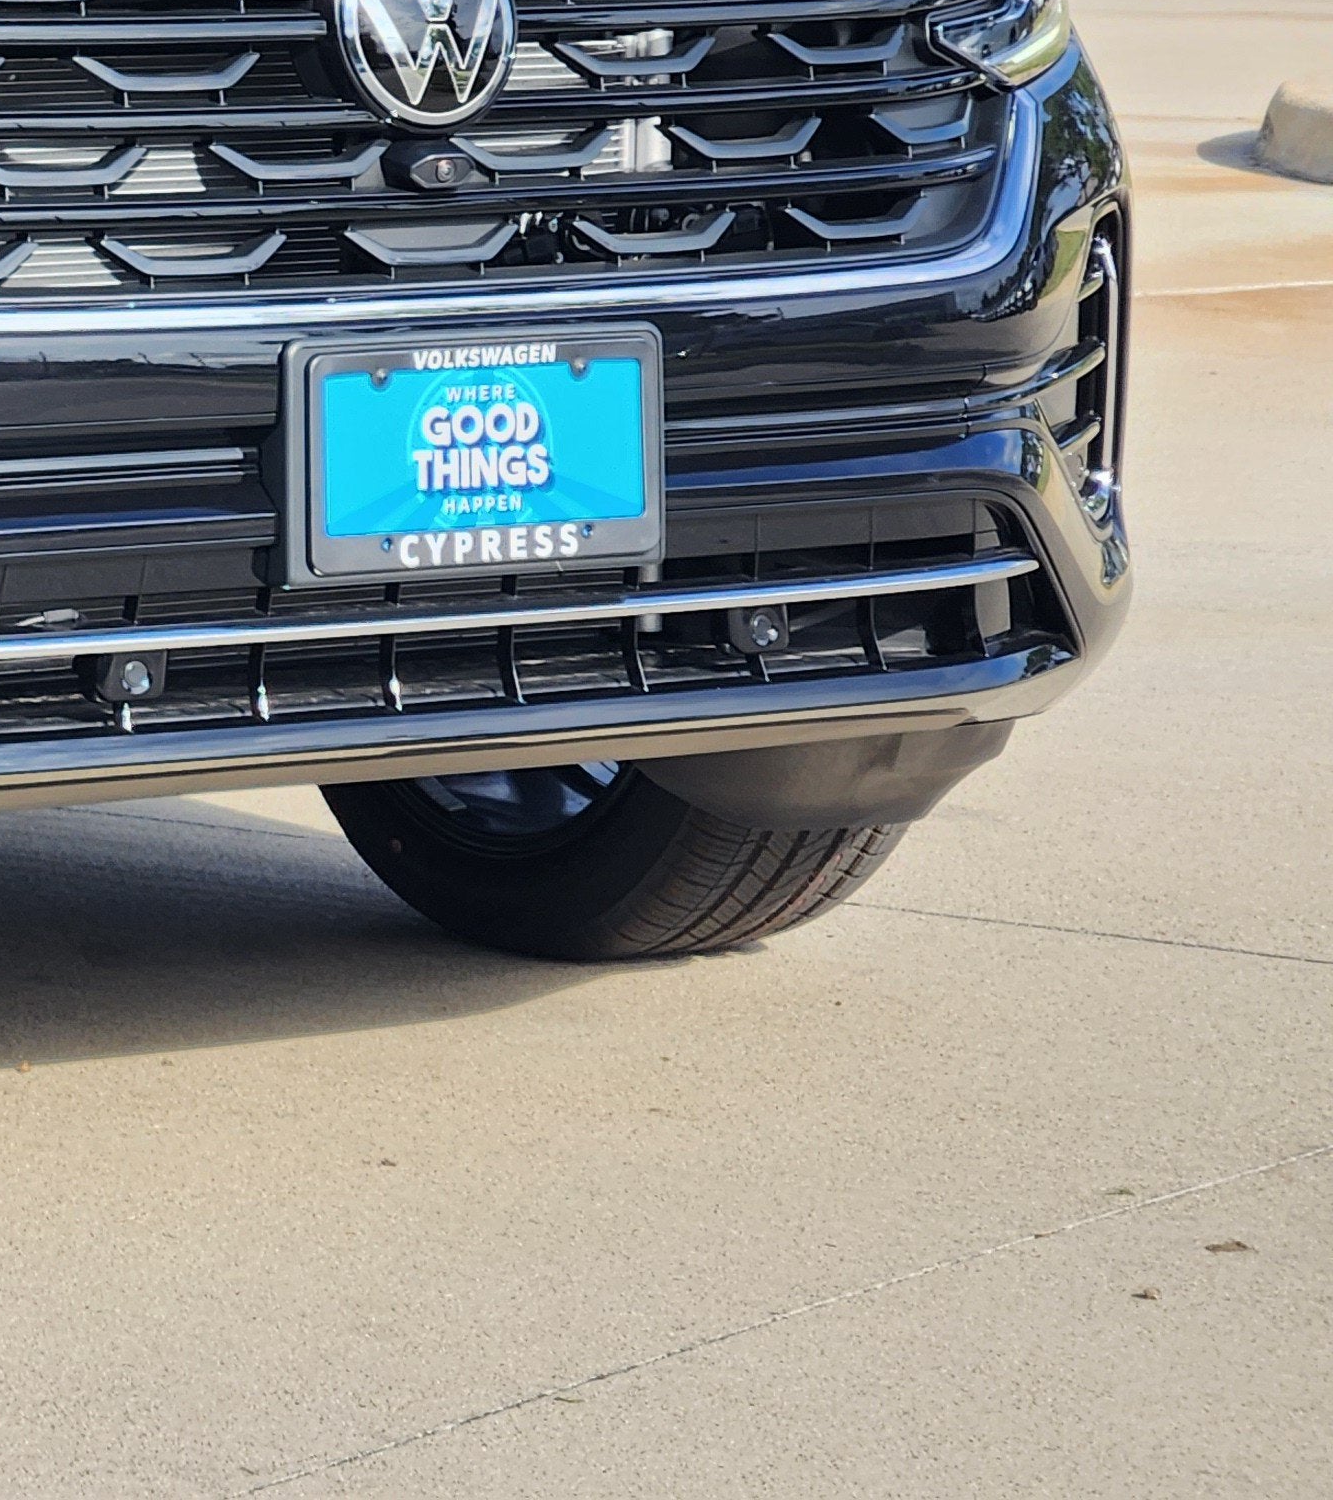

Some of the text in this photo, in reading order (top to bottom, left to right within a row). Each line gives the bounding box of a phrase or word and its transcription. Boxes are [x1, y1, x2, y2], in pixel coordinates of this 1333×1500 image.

[413, 343, 557, 370] VOLKSWAGEN
[446, 383, 517, 402] WHERE
[422, 401, 539, 447] GOOD
[413, 444, 550, 491] THINGS
[443, 491, 523, 514] HAPPEN
[400, 523, 579, 569] CYPRESS
